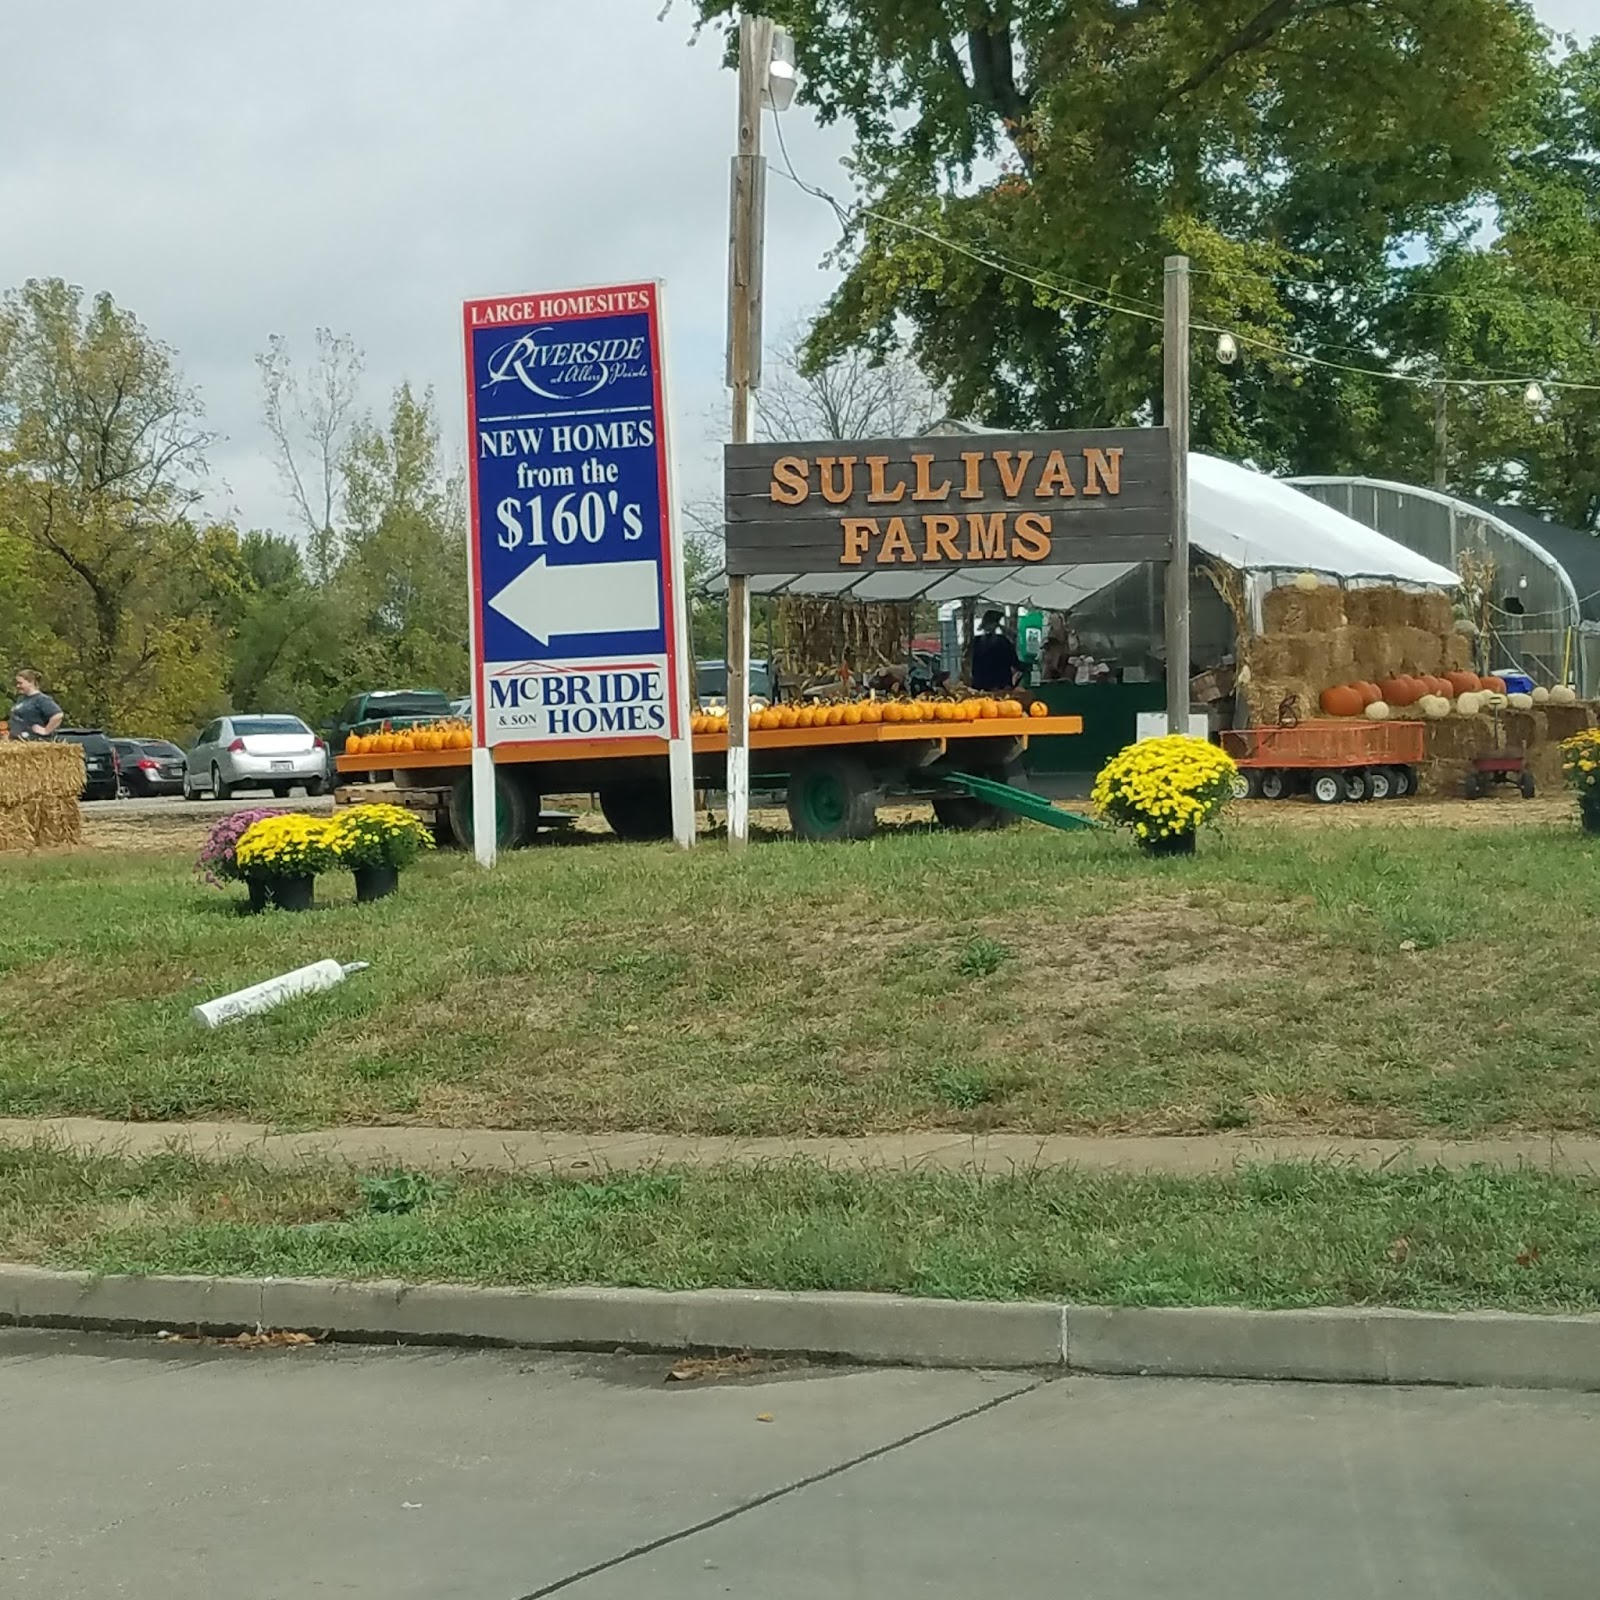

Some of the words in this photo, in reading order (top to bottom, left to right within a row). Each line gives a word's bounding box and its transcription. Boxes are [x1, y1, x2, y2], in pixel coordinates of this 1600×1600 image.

[471, 302, 535, 325] LARGE
[539, 290, 650, 318] HOMESITES
[480, 327, 645, 399] RIVERSIDE
[480, 428, 544, 458] NEW
[550, 420, 654, 453] HOMES
[517, 462, 574, 489] from
[581, 457, 619, 483] the
[770, 447, 1124, 505] SULLIVAN
[496, 490, 643, 551] $160's
[839, 512, 1053, 564] FARMS
[498, 716, 508, 726] &
[511, 714, 537, 726] SON
[547, 705, 665, 734] HOMES
